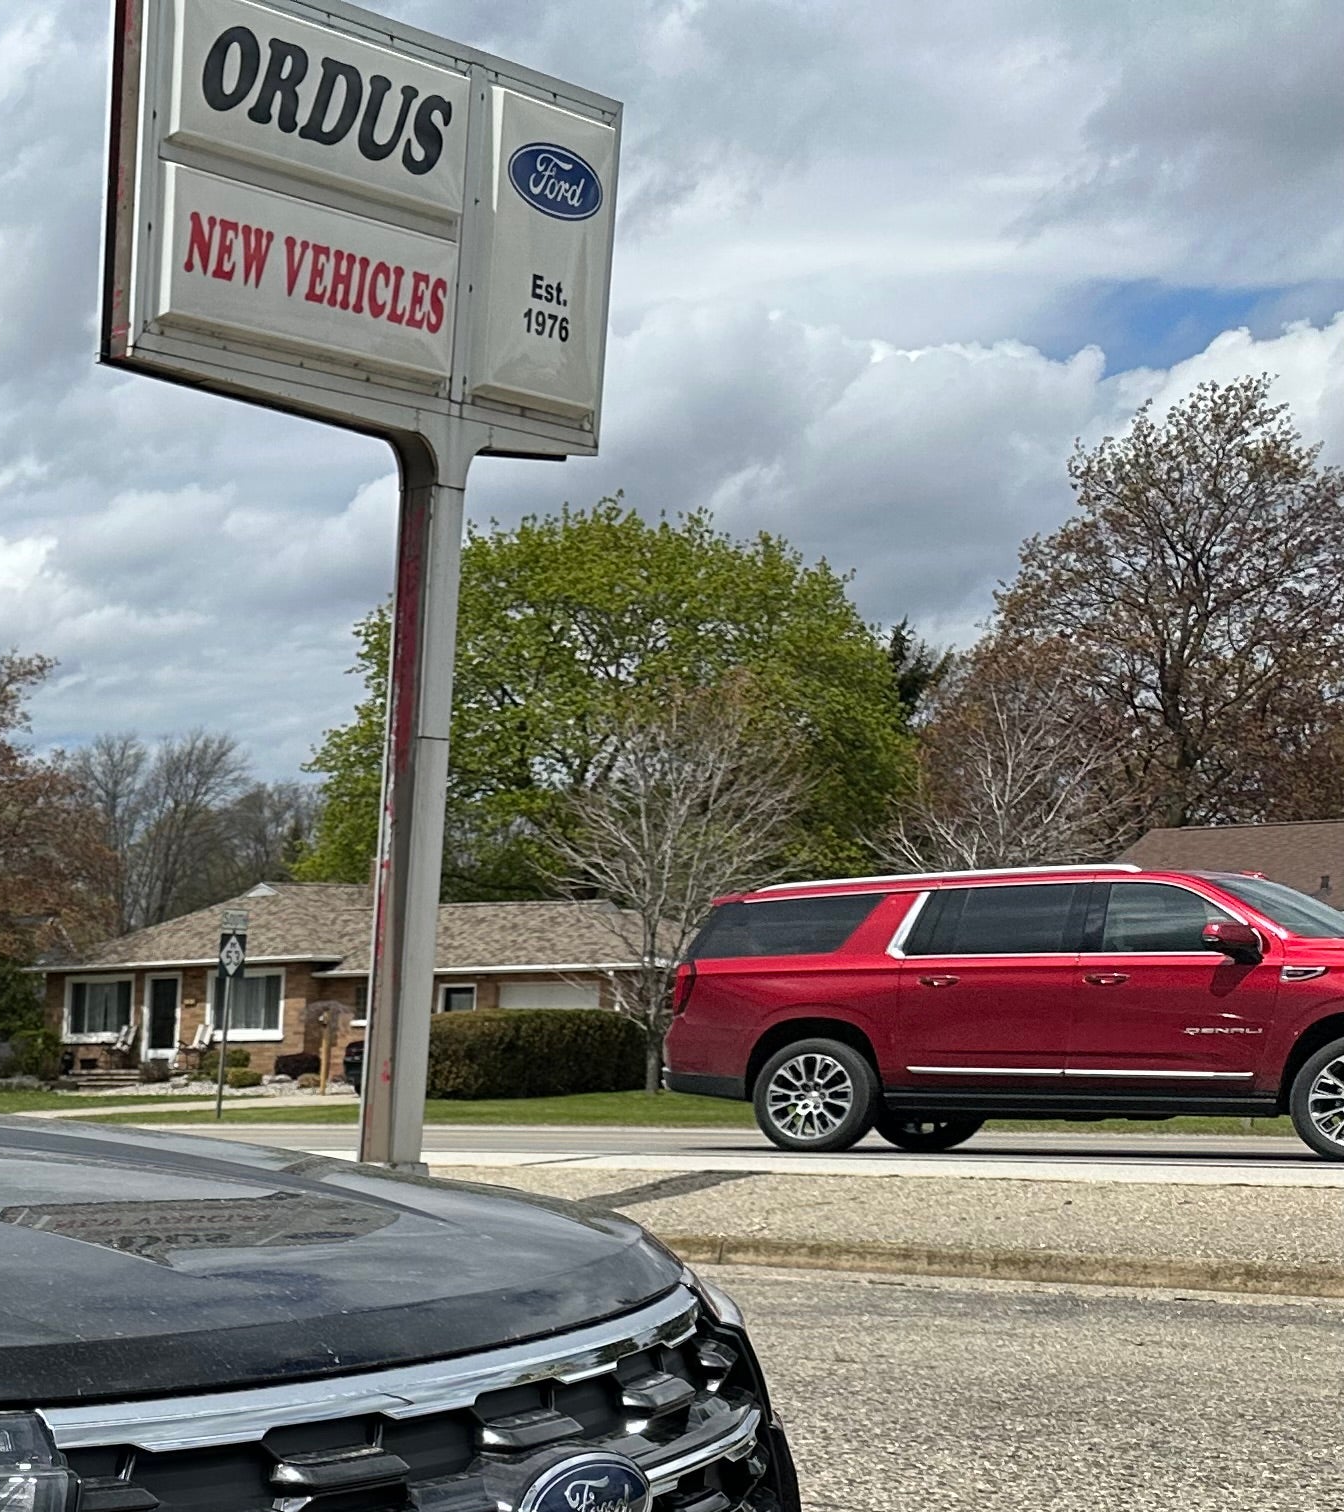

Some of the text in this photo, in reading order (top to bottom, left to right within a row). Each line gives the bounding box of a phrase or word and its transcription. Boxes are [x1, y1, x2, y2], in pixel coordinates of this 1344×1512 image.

[202, 25, 452, 175] ORDUS
[528, 152, 584, 207] Ford
[184, 211, 448, 334] NEW VEHICLES
[531, 273, 568, 307] Est.
[523, 308, 570, 342] 1976
[226, 950, 241, 967] 53
[1184, 1027, 1263, 1036] DENALI
